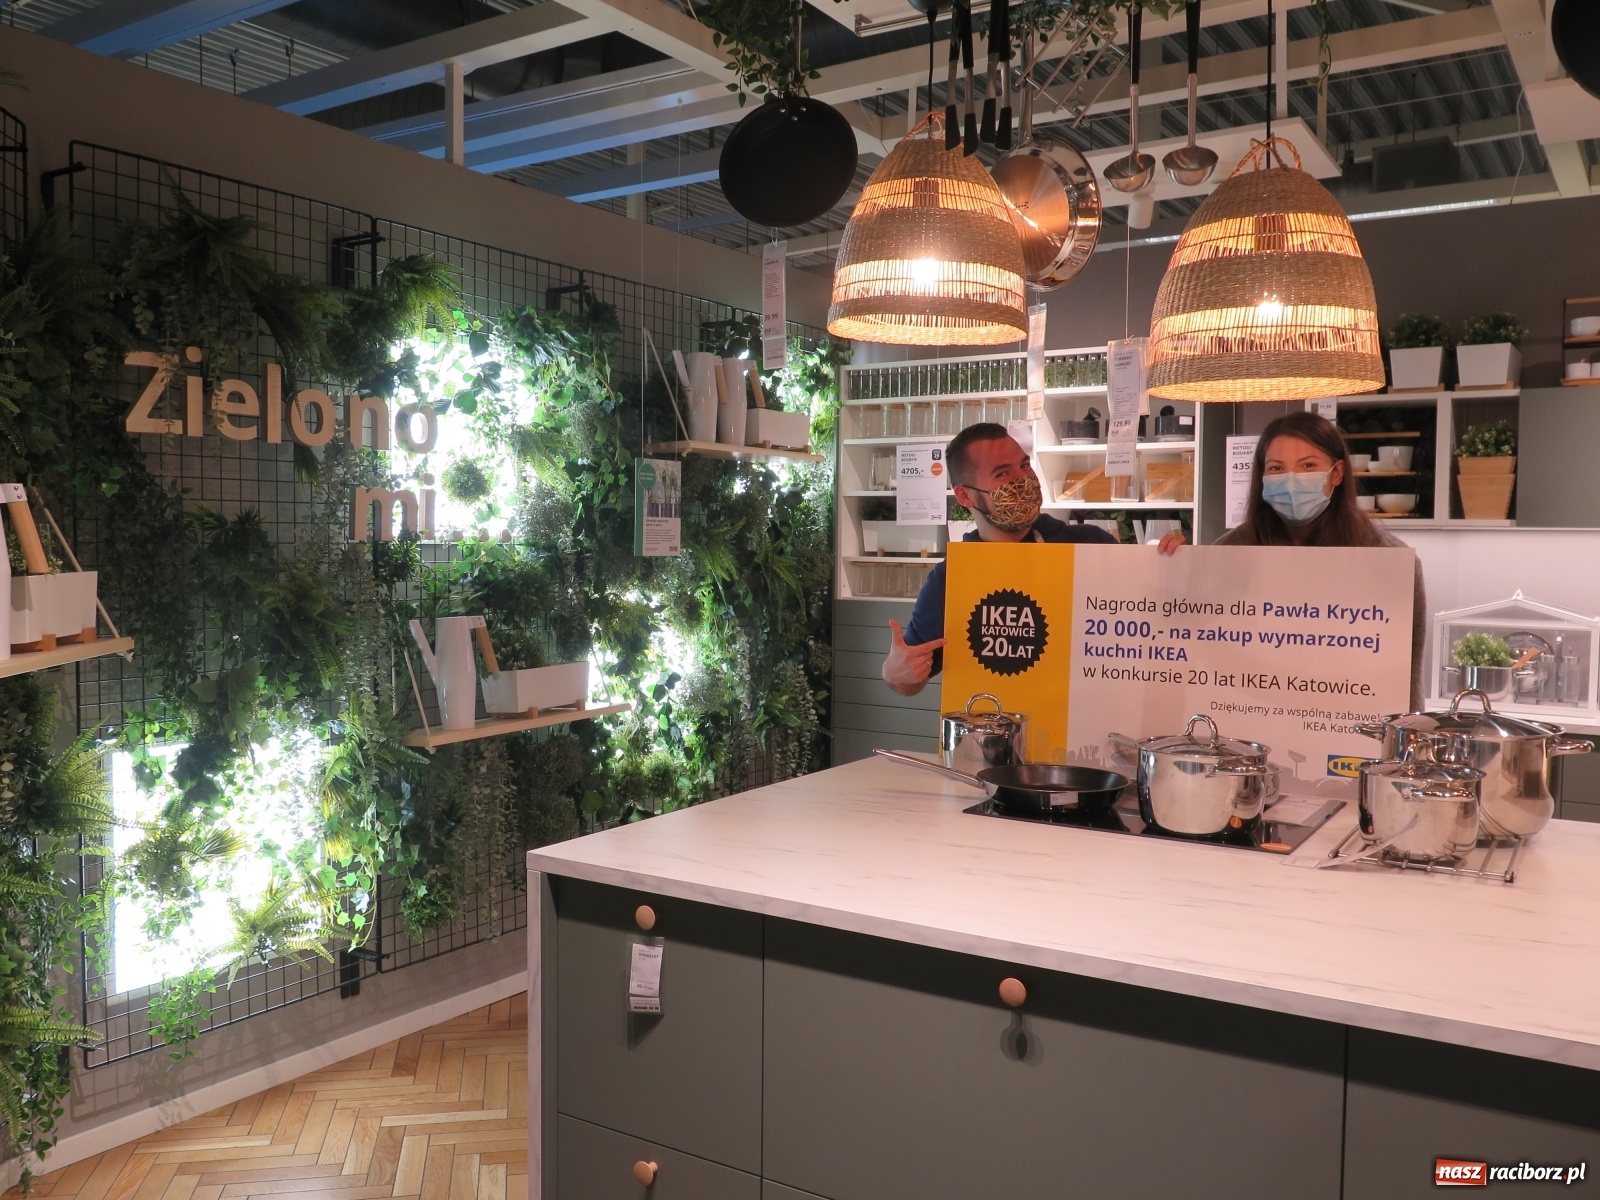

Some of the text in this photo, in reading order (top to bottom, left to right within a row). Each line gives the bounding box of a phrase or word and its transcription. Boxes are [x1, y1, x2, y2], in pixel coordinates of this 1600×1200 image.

[124, 346, 439, 455] Zielono
[981, 605, 1035, 627] IKEA
[1086, 596, 1390, 624] Nagroda główna dla Pawła Krych,
[981, 626, 1035, 637] KATOWICE
[1084, 618, 1380, 653] 20 000,- na zakup wymarzonej
[1084, 642, 1188, 662] kuchni IKEA
[1083, 664, 1376, 697] w konkursie 20 lat IKEA Katowice.
[1210, 701, 1381, 723] Dziękujemy za wspólną zabawę!
[1303, 721, 1327, 732] IKEA
